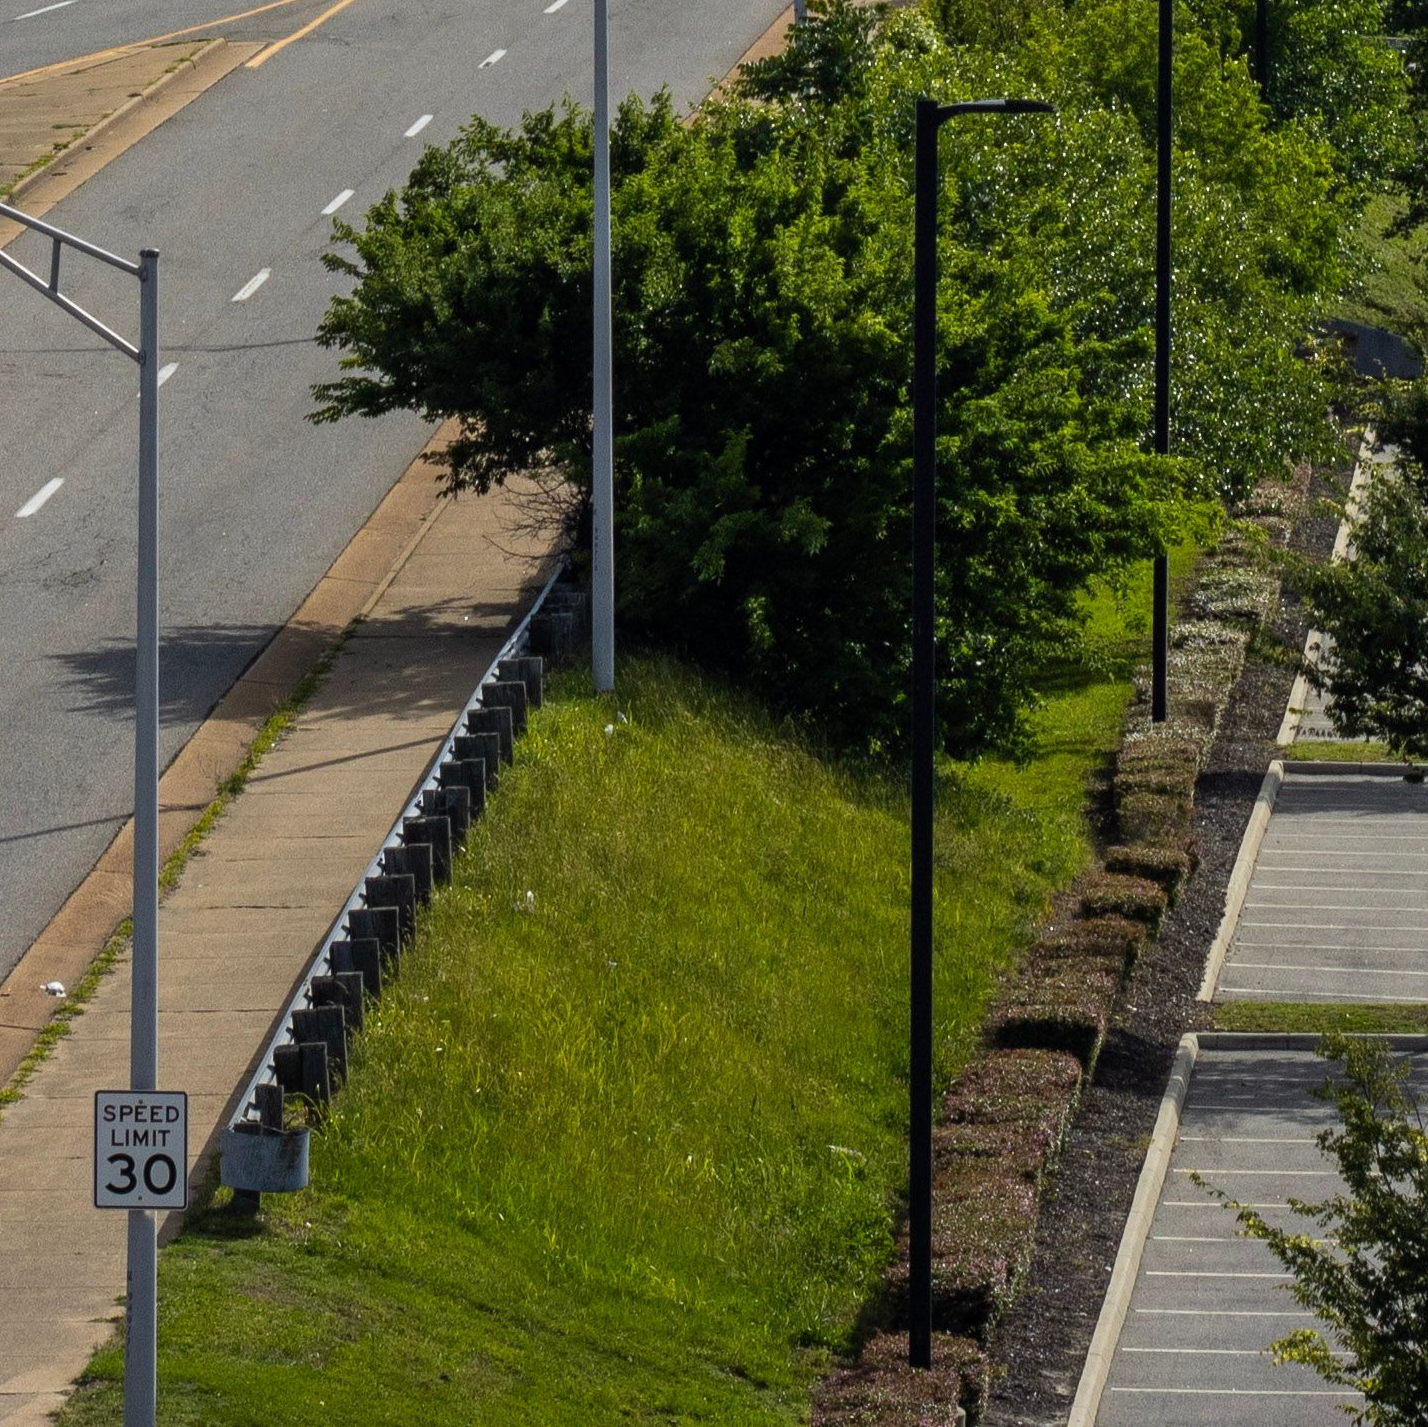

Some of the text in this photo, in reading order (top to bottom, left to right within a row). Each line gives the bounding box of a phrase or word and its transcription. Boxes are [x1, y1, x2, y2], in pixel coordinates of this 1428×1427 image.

[103, 1104, 180, 1123] SPEED
[111, 1129, 171, 1147] LIMIT
[104, 1153, 178, 1195] 30
